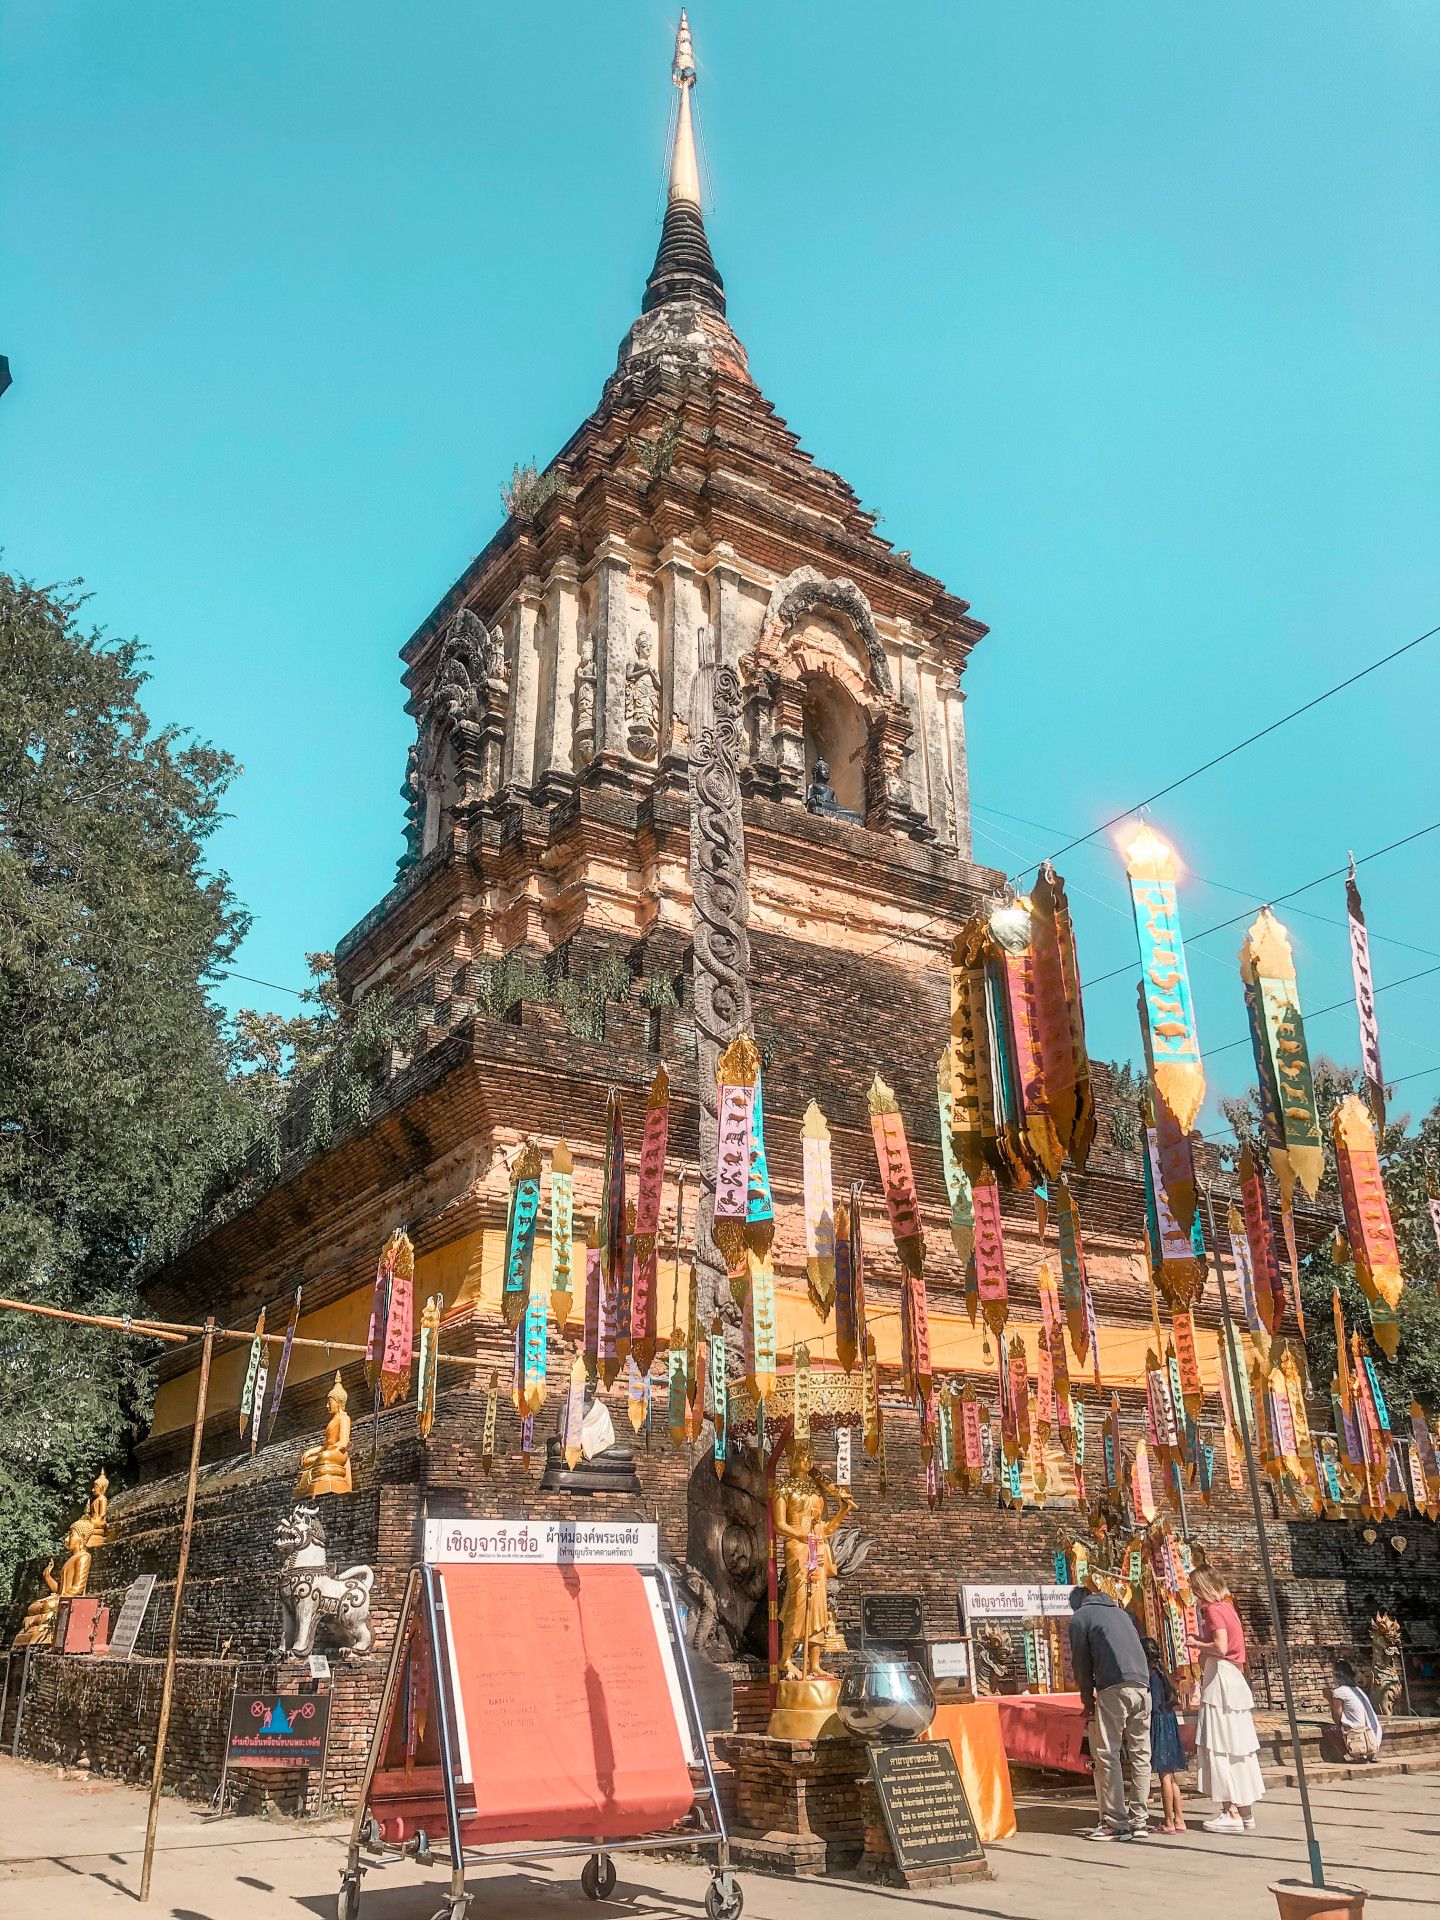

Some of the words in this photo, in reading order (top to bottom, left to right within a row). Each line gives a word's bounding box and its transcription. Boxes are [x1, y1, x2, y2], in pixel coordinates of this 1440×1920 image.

[446, 1525, 538, 1558] เชิญจารึกชื่อ
[546, 1526, 639, 1545] ผ้าห่มองค์พระเจดีย์
[971, 1589, 1024, 1612] เชิญจารึกชื่อ
